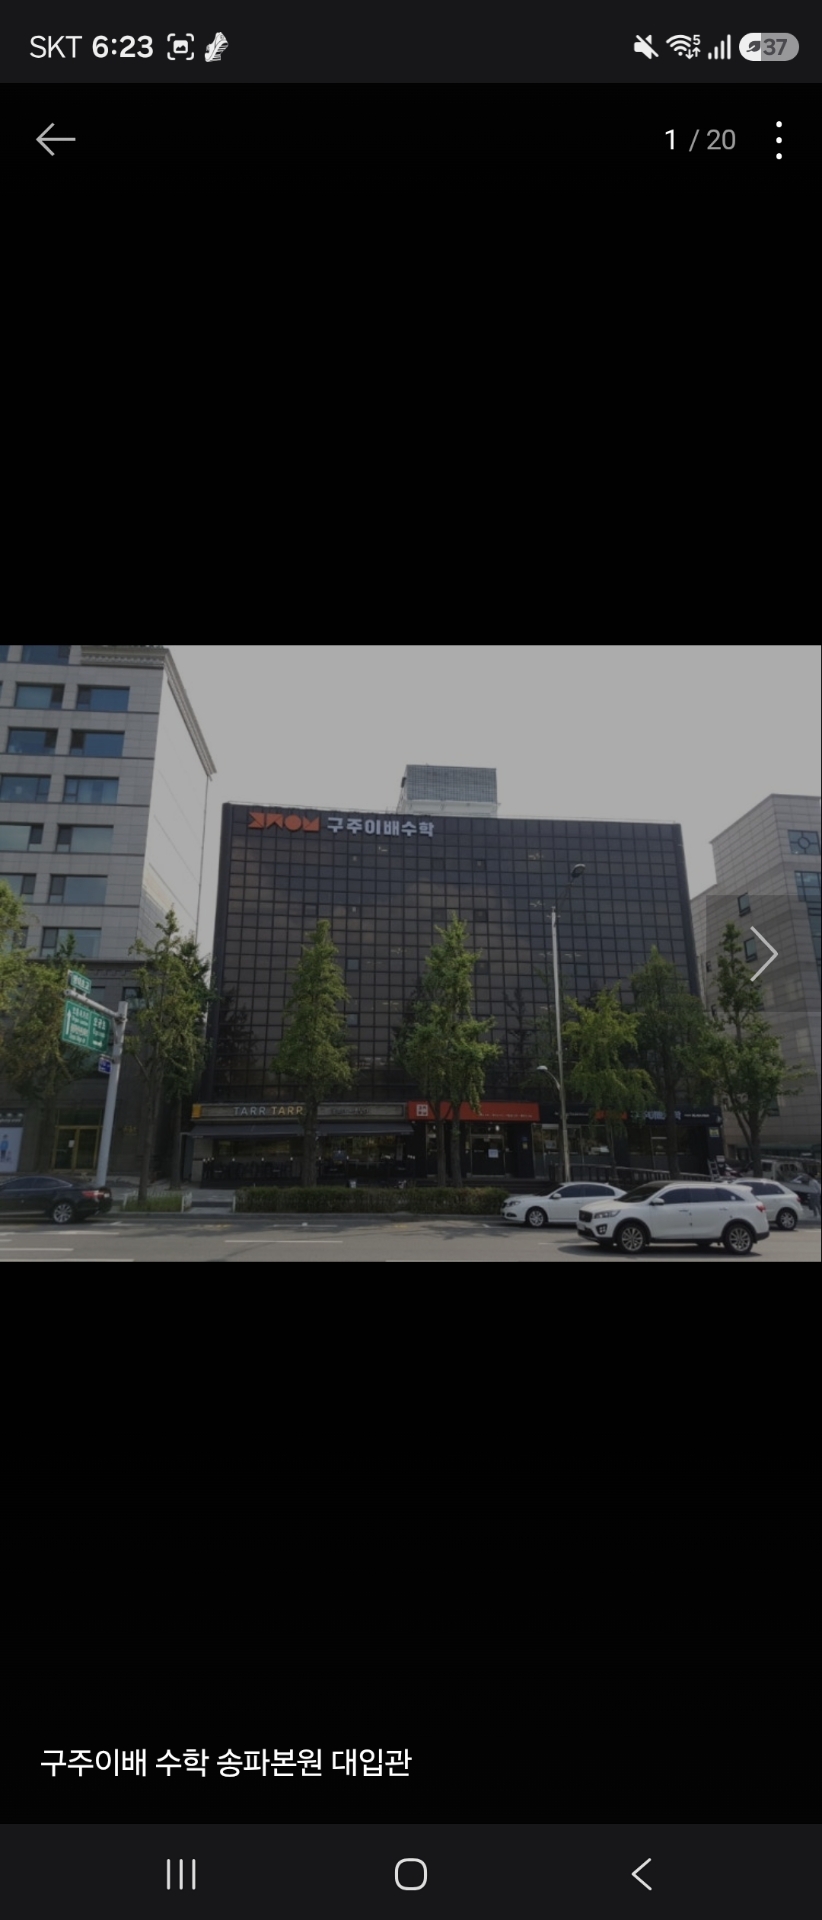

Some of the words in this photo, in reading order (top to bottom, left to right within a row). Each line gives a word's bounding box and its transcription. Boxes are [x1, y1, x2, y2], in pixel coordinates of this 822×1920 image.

[327, 816, 434, 837] 구주이배수학
[233, 1106, 266, 1116] TARR
[271, 1106, 304, 1116] TARR
